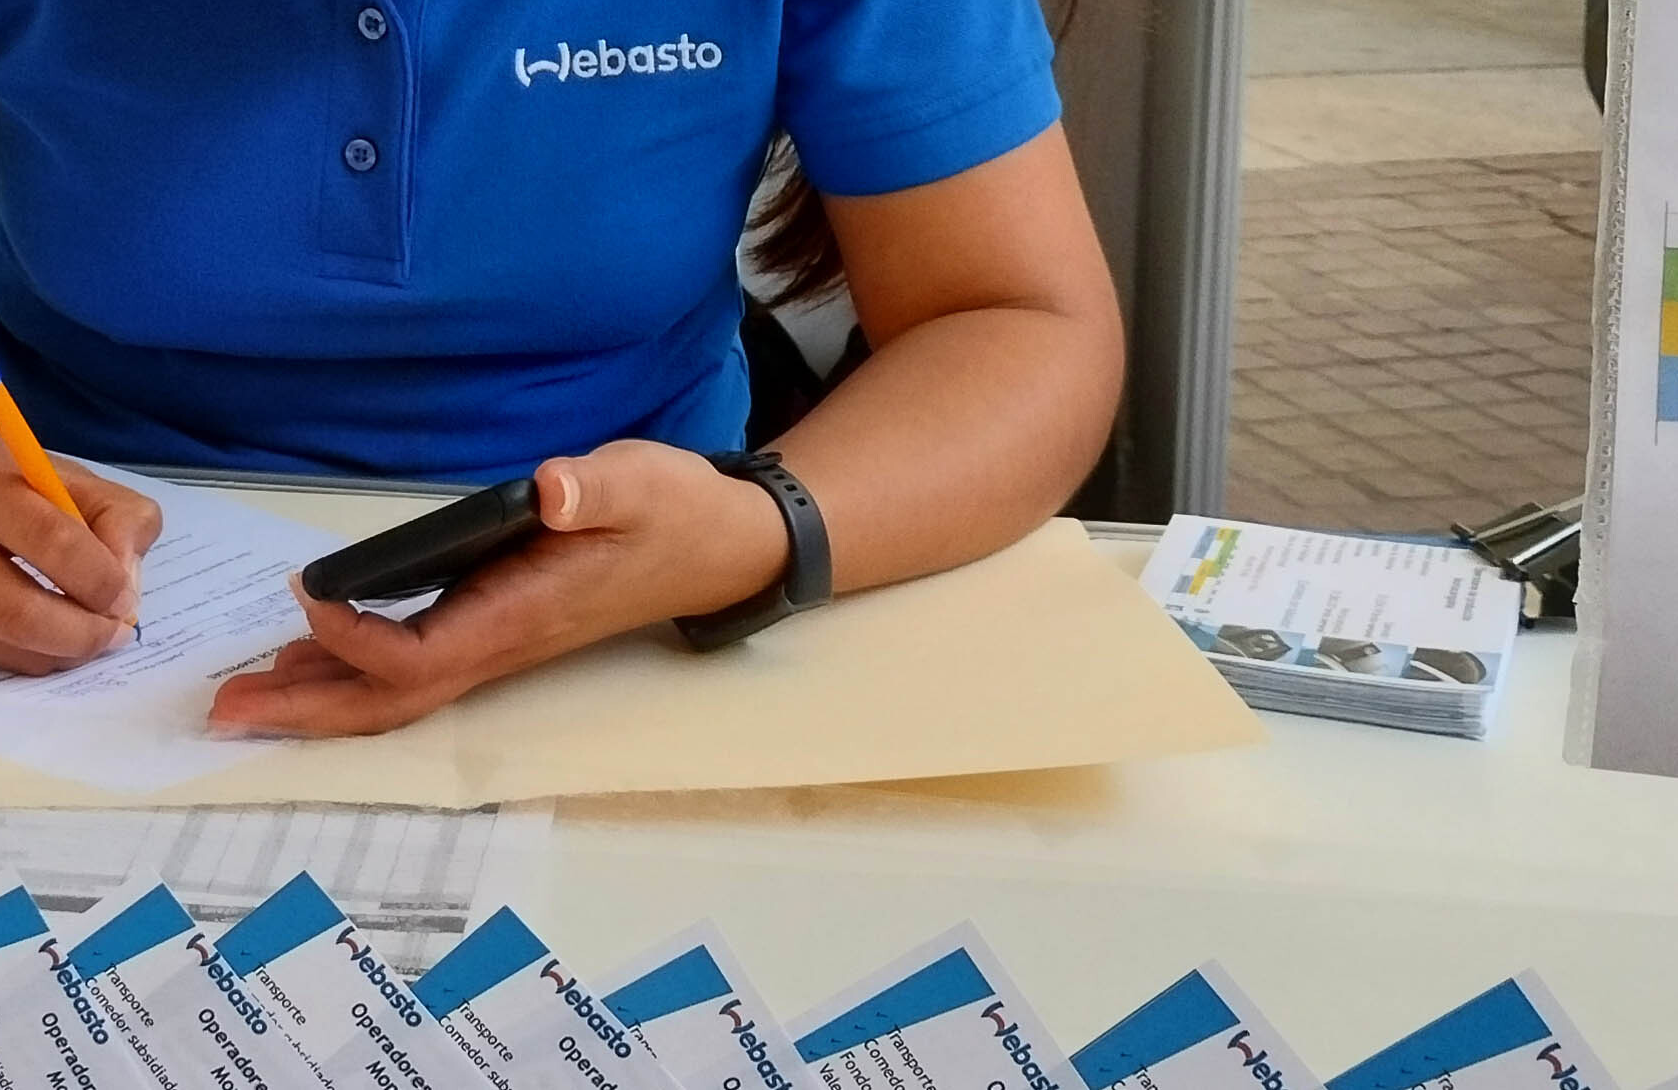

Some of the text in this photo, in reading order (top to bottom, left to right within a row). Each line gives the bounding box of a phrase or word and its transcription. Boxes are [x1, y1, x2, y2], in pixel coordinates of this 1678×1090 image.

[515, 33, 722, 87] Webasto
[38, 938, 110, 1046] Webasto
[84, 977, 132, 1034] Comedor
[105, 963, 155, 1029] Transporte
[186, 932, 268, 1036] Webasto
[253, 962, 307, 1026] Transporte
[335, 925, 423, 1028] Webasto
[540, 958, 632, 1059] Webasto
[438, 1014, 491, 1071] Comedor
[458, 997, 514, 1062] Transporte
